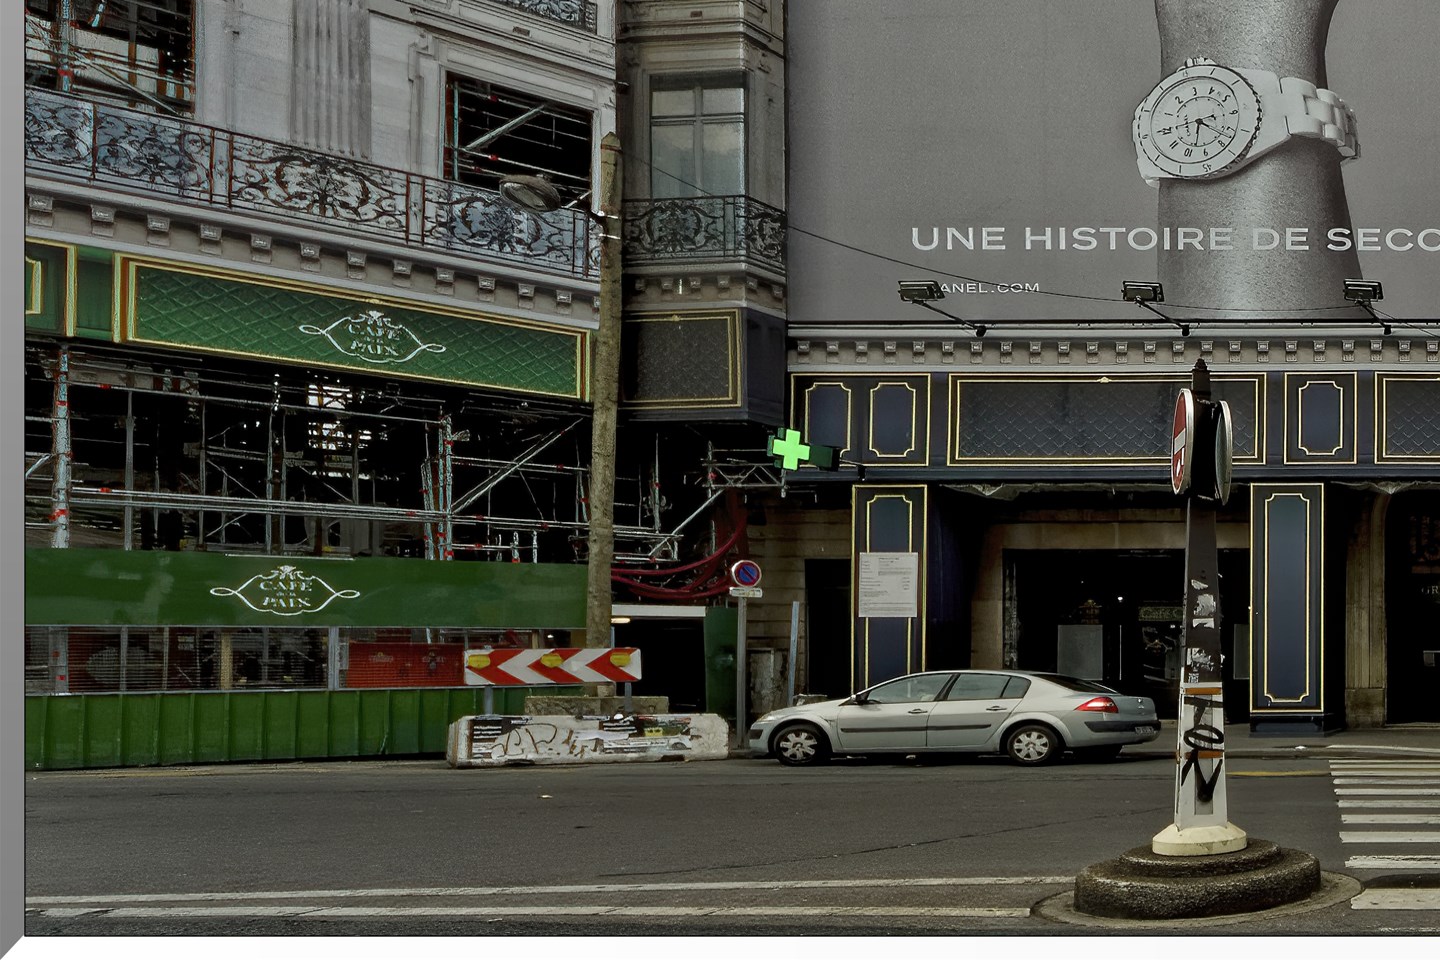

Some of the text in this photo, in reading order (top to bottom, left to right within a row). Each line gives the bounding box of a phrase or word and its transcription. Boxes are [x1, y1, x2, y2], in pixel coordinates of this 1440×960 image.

[911, 227, 1006, 251] UNE
[1025, 227, 1234, 251] HISTOIRE
[1252, 227, 1310, 251] DE
[939, 282, 1041, 293] ANEL.COM
